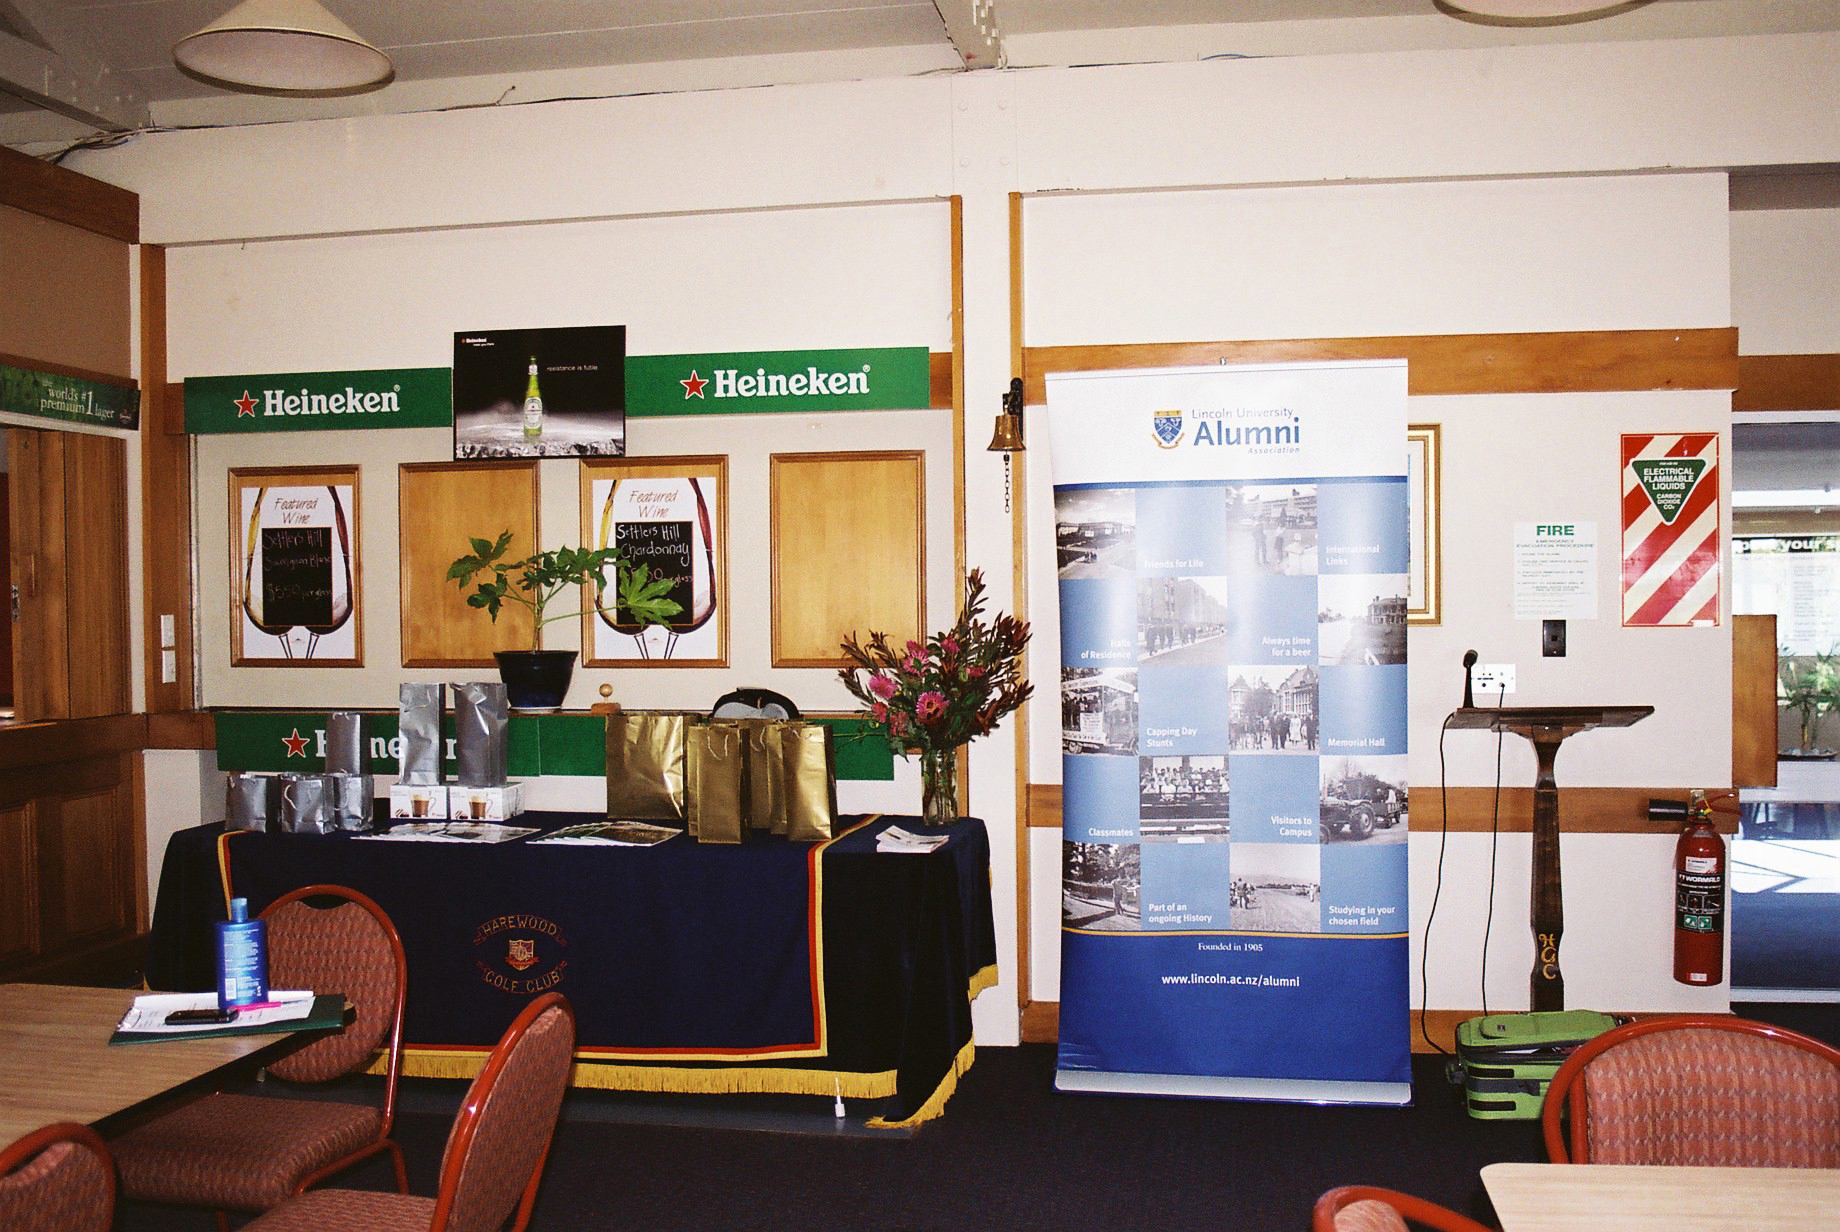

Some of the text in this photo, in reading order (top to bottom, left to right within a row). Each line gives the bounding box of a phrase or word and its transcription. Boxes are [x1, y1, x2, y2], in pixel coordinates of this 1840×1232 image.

[48, 387, 79, 401] world's
[40, 398, 85, 413] premium
[95, 403, 115, 420] lager
[1192, 407, 1293, 419] Lincoln University
[1193, 417, 1300, 446] Alumni
[1643, 467, 1695, 476] ELECTRICAL
[1643, 475, 1695, 483] FLAMMABLE
[1652, 482, 1686, 491] LIQUIDS
[629, 489, 679, 503] Featured
[274, 497, 319, 510] Featured
[639, 505, 669, 518] Wine
[283, 512, 310, 524] Wine
[661, 523, 680, 542] Hill
[1536, 525, 1575, 536] FIRE
[620, 540, 690, 567] Chardonnay
[1326, 544, 1380, 554] International
[1175, 559, 1188, 568] for
[1189, 559, 1204, 568] Life
[1326, 557, 1348, 565] Links
[1261, 636, 1311, 646] Always time
[1081, 650, 1131, 659] of Residence
[1272, 648, 1285, 656] for
[1292, 648, 1311, 656] beer
[1146, 727, 1198, 738] Capping Day
[1146, 739, 1174, 748] Stunts
[1328, 738, 1385, 747] Memorial Hall
[1271, 815, 1313, 825] Visitors to
[1088, 827, 1134, 837] Classmates
[1280, 827, 1313, 838] Campus
[1149, 903, 1187, 912] Part of an
[1328, 905, 1396, 916] Studying in your
[1149, 914, 1213, 924] ongoing History
[1328, 916, 1379, 926] chosen field
[482, 915, 558, 936] HAREWOOD
[1198, 943, 1264, 952] Founded in 1905
[526, 970, 561, 992] CLUB
[1161, 973, 1300, 988] www.lincoln.ac.nz/alumni
